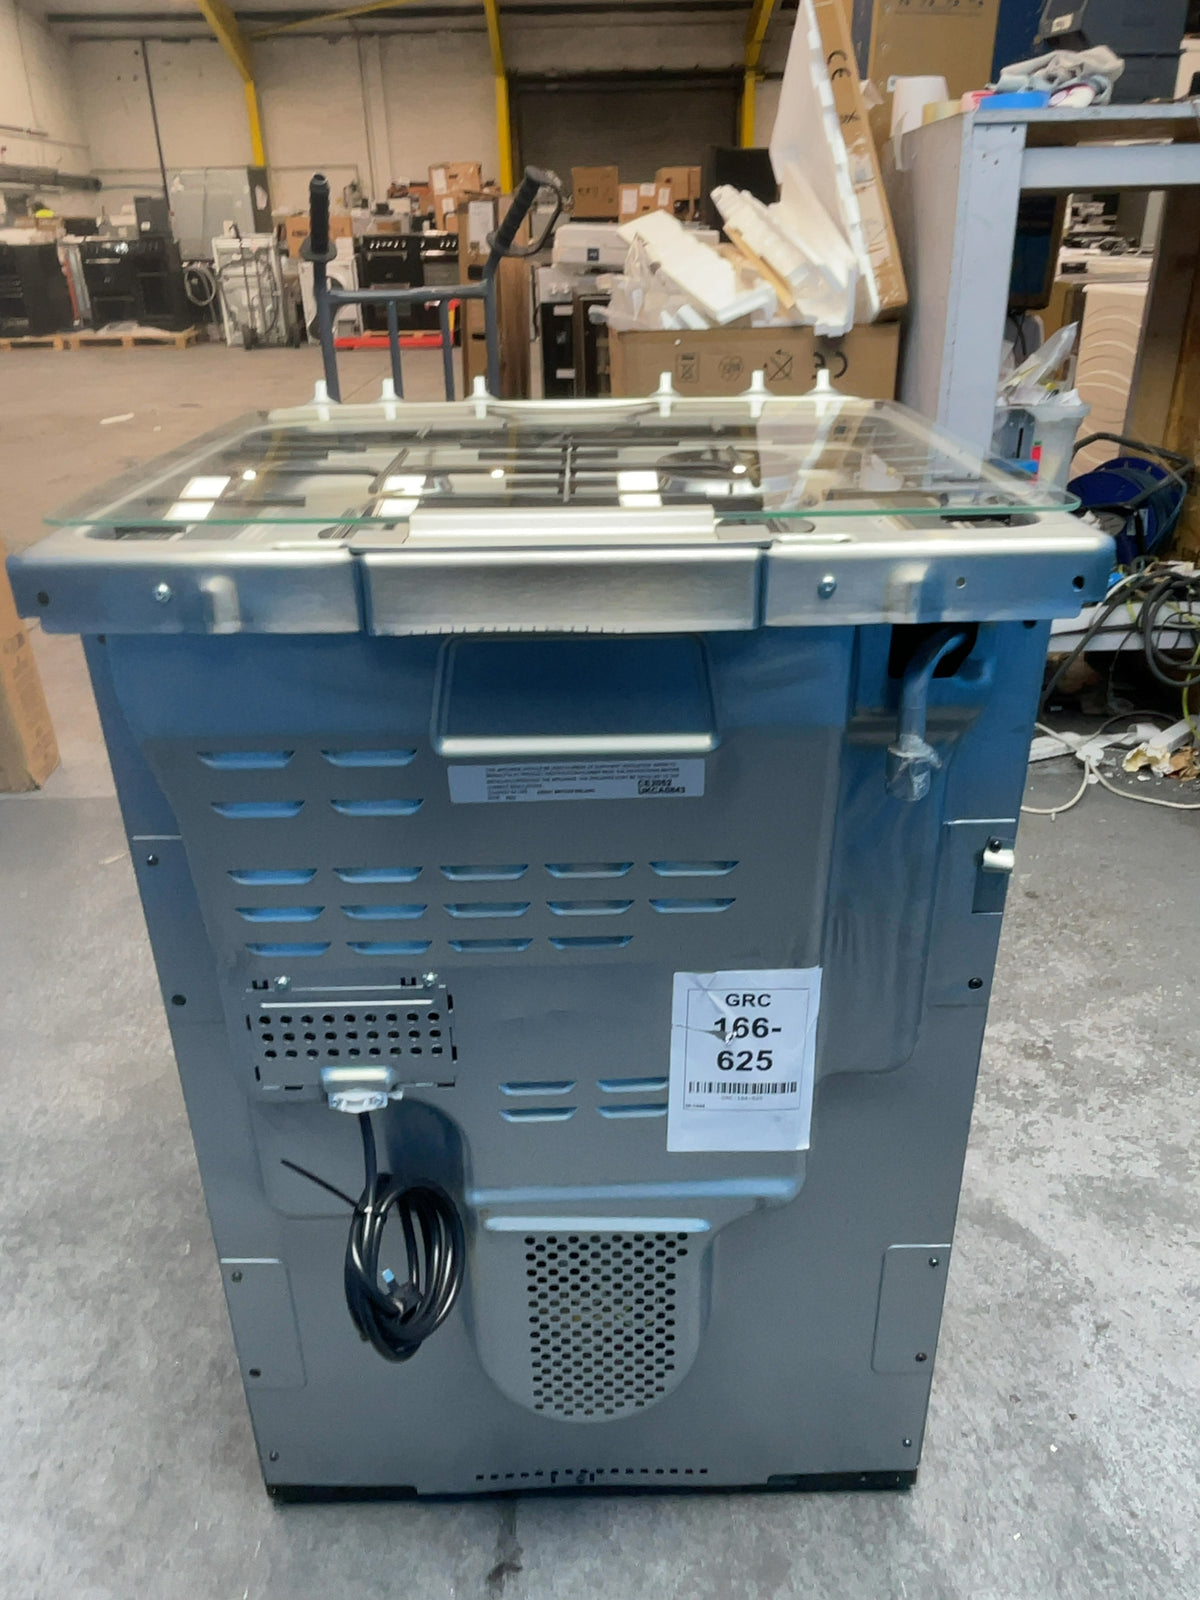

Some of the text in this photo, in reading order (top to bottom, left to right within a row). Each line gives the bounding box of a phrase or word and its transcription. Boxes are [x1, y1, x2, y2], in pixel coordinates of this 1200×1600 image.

[725, 993, 771, 1007] GRC
[713, 1017, 782, 1038] 166-
[717, 1050, 772, 1071] 625
